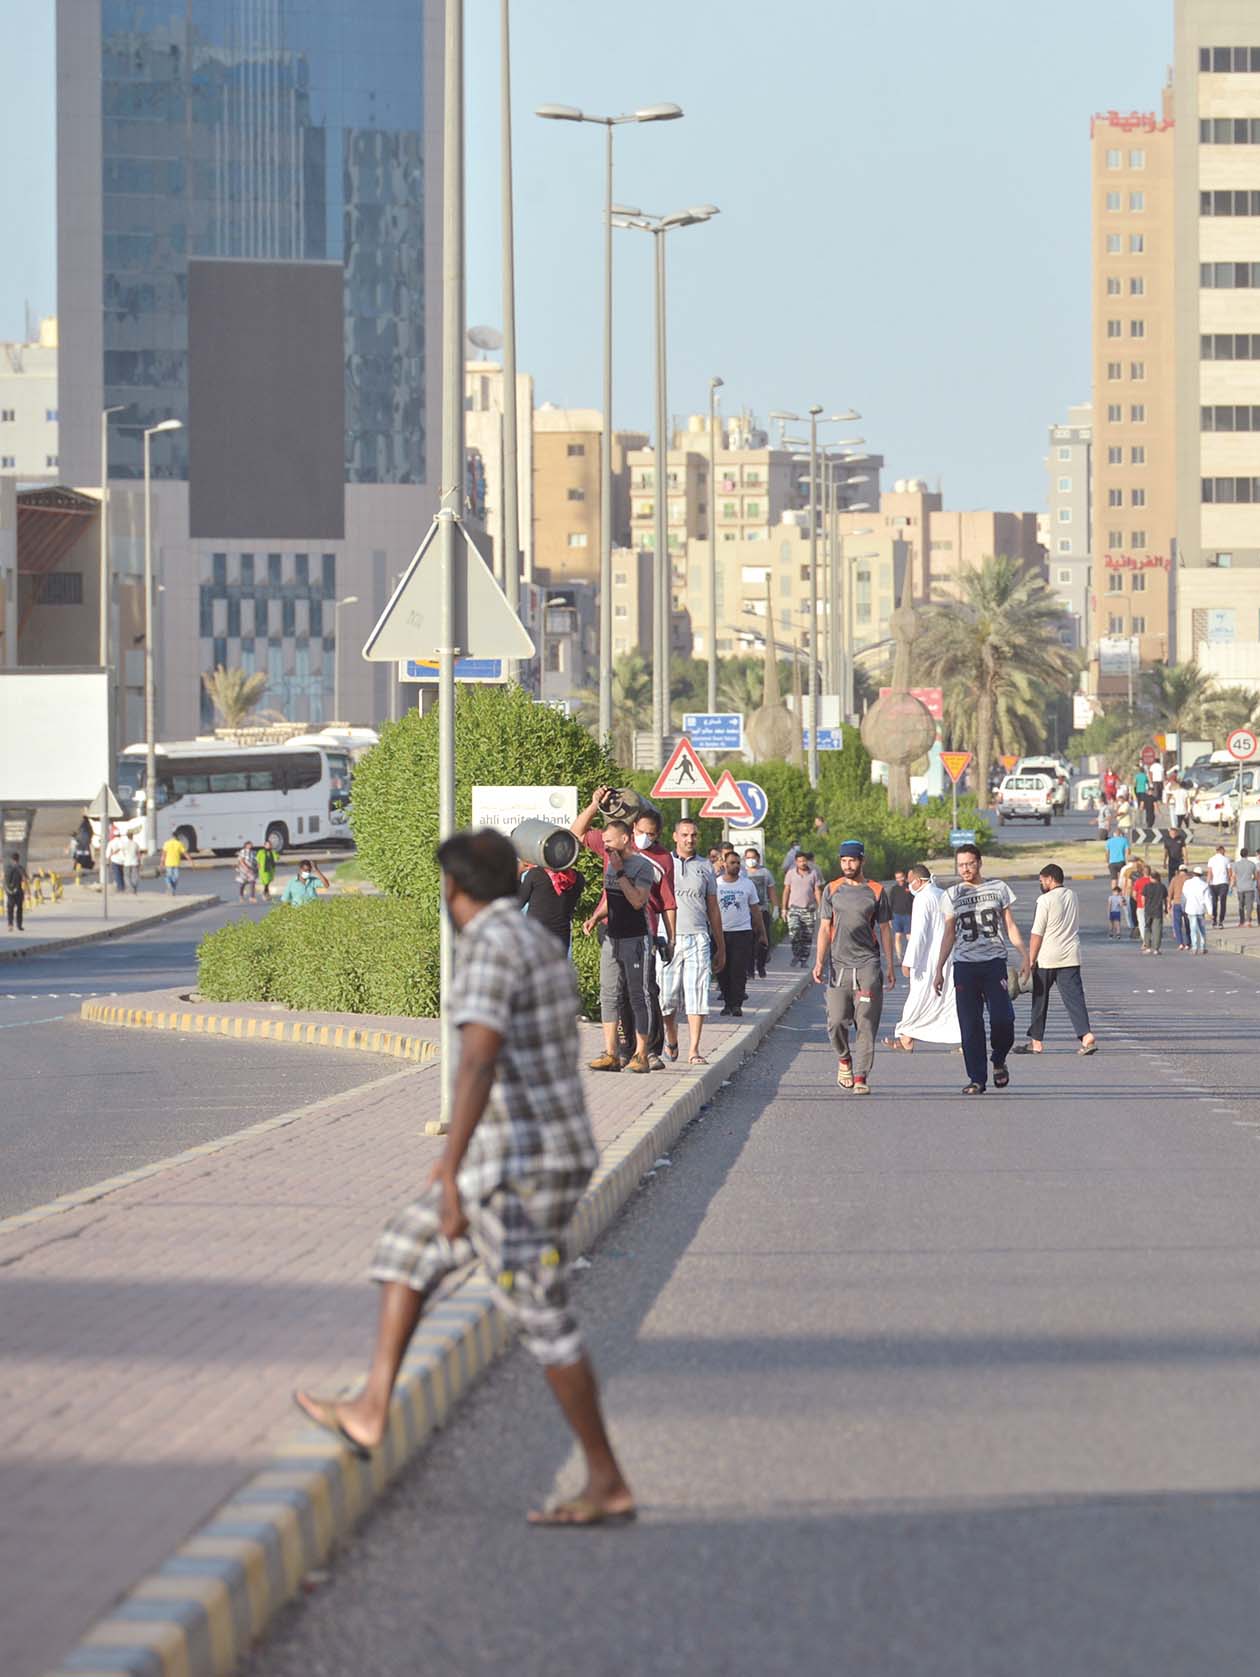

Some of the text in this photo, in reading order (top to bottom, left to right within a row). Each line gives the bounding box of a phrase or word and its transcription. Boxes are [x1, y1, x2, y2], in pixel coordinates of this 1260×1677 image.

[1233, 738, 1251, 750] 45
[479, 814, 500, 825] ahli
[543, 813, 571, 825] bank
[959, 907, 999, 943] 99
